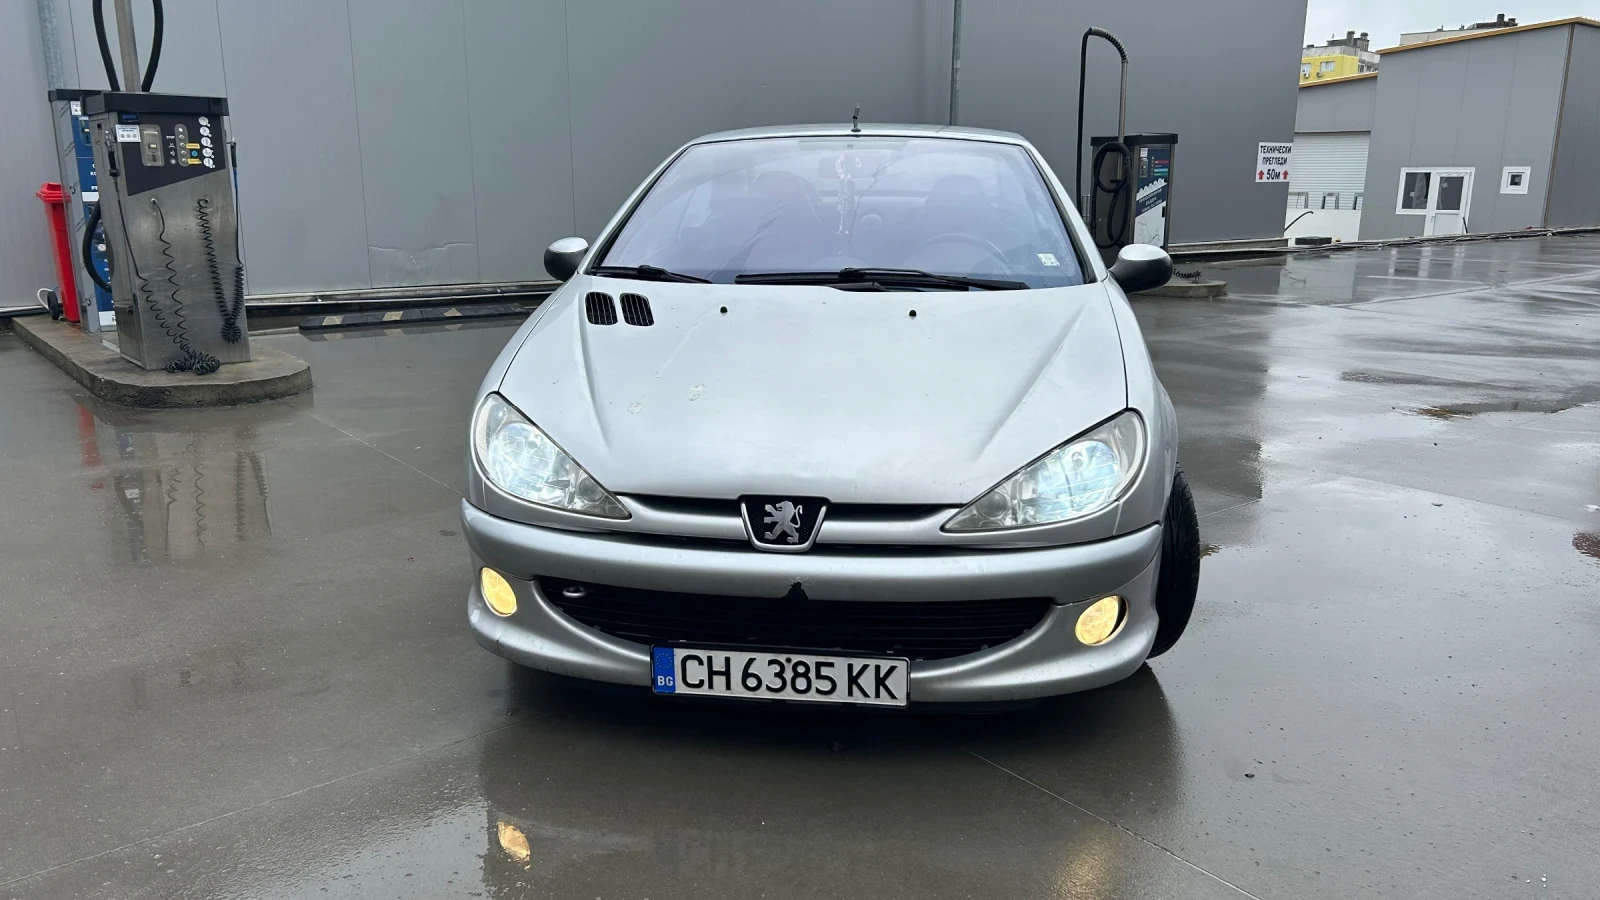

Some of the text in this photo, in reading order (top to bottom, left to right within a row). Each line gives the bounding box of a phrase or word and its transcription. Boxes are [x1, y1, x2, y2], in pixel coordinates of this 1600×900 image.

[1260, 145, 1292, 154] ТЕХНИЧЕСКИ
[1262, 156, 1288, 166] ПРЕГЛЕДИ
[657, 676, 674, 687] BG
[680, 654, 898, 700] CH 6385 KK
